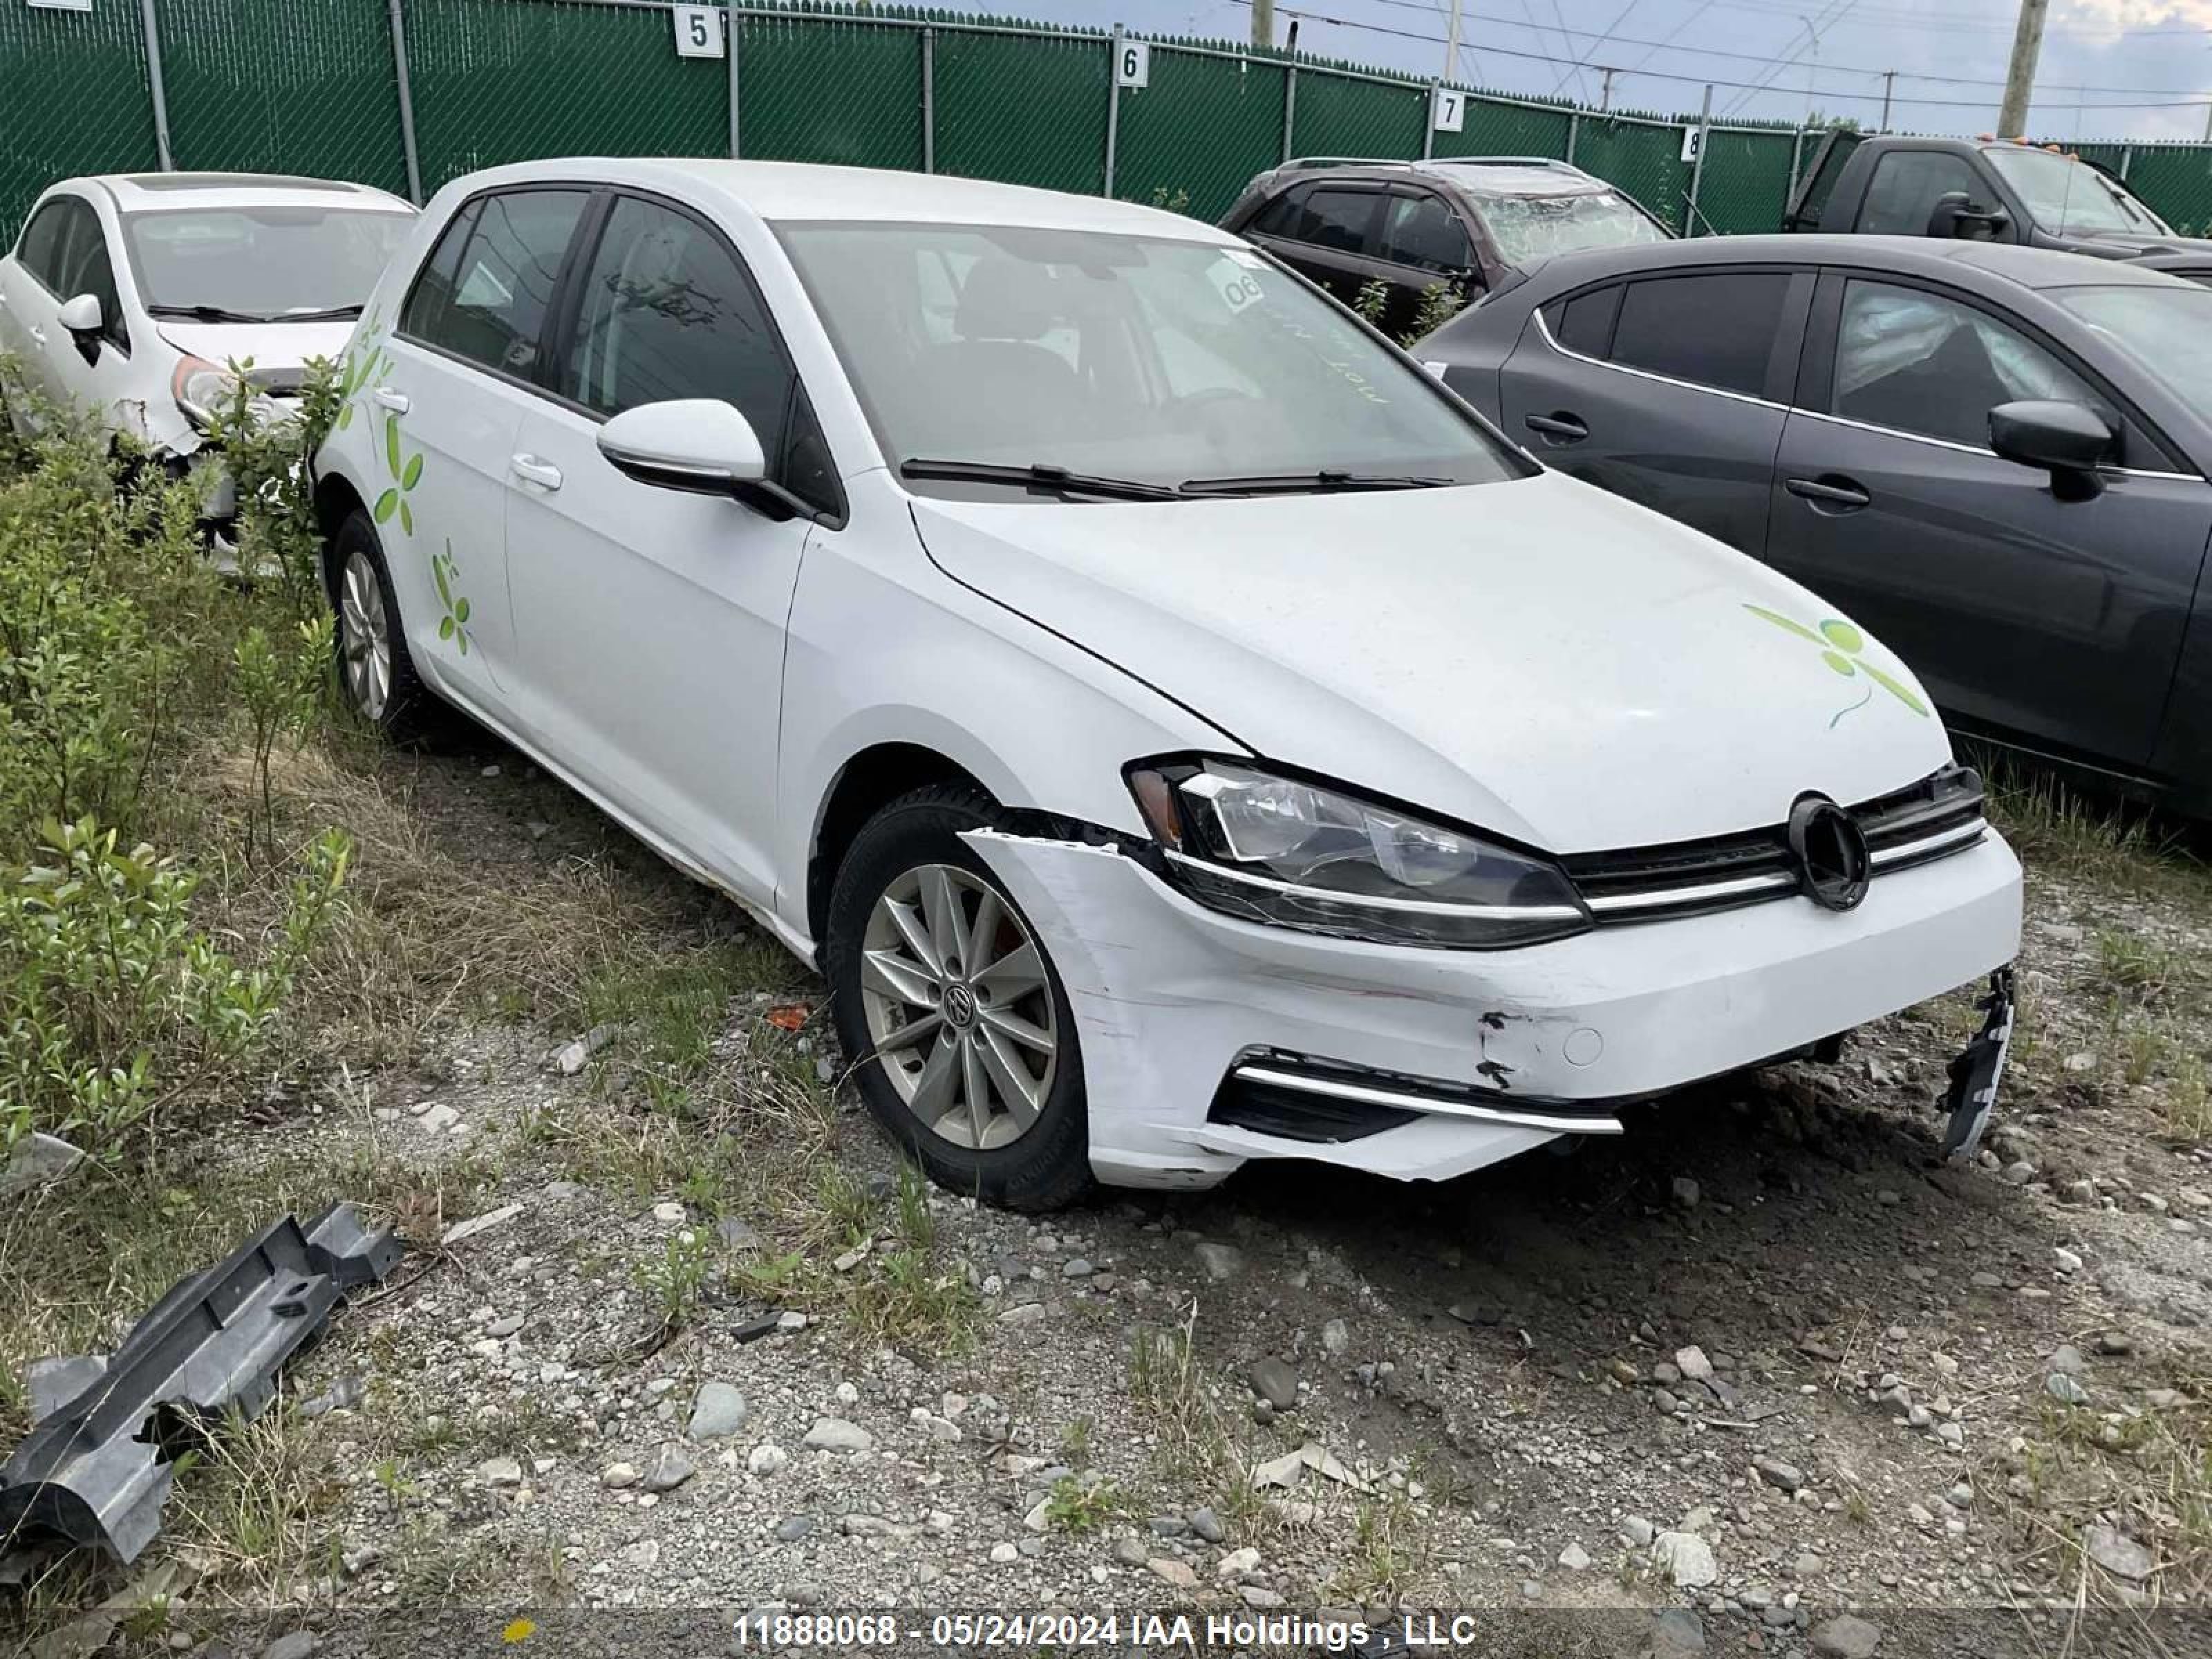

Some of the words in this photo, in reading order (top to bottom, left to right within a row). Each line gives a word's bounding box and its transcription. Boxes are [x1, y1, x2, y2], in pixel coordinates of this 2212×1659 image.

[690, 15, 706, 46] 5
[1124, 48, 1137, 77] 6
[1446, 97, 1456, 122] 7
[1690, 133, 1700, 155] 8
